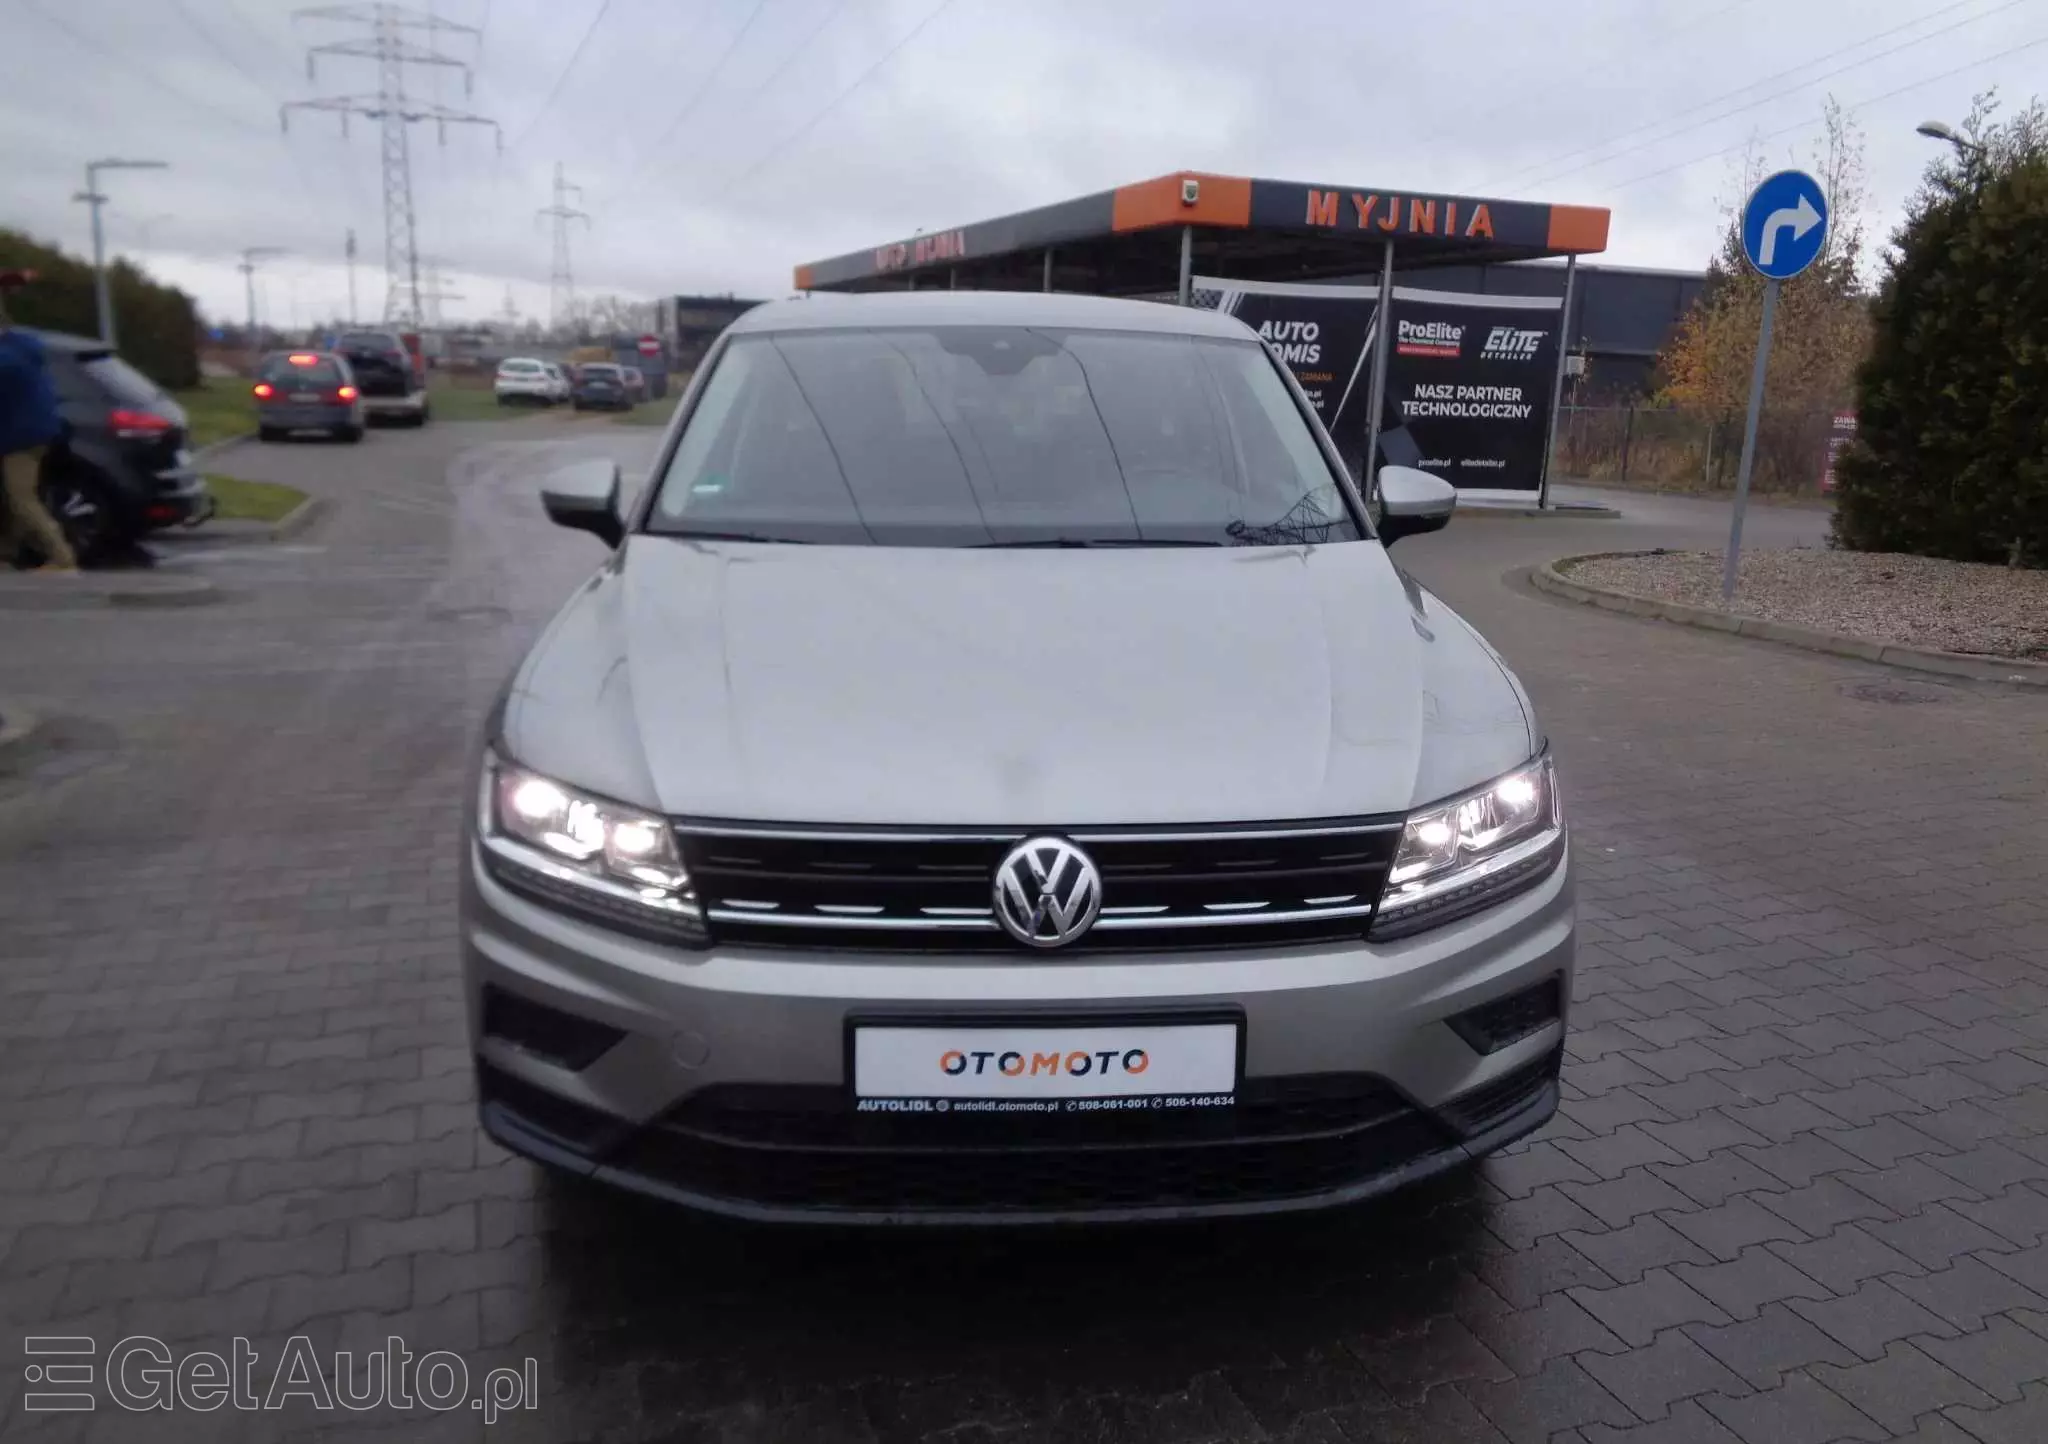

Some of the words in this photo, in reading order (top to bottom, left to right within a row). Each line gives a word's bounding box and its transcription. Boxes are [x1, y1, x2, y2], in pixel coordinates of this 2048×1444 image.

[1305, 188, 1494, 240] MYJNIA
[1259, 320, 1320, 342] AUTO
[1398, 319, 1462, 340] ProElite
[1271, 342, 1322, 363] OMIS
[1415, 383, 1454, 399] NASZ
[1457, 385, 1522, 401] PARTNER
[1402, 401, 1532, 418] TECHNOLOGICZNY
[939, 1048, 1149, 1077] OTOMOTO
[856, 1099, 933, 1112] AUTOLIDL
